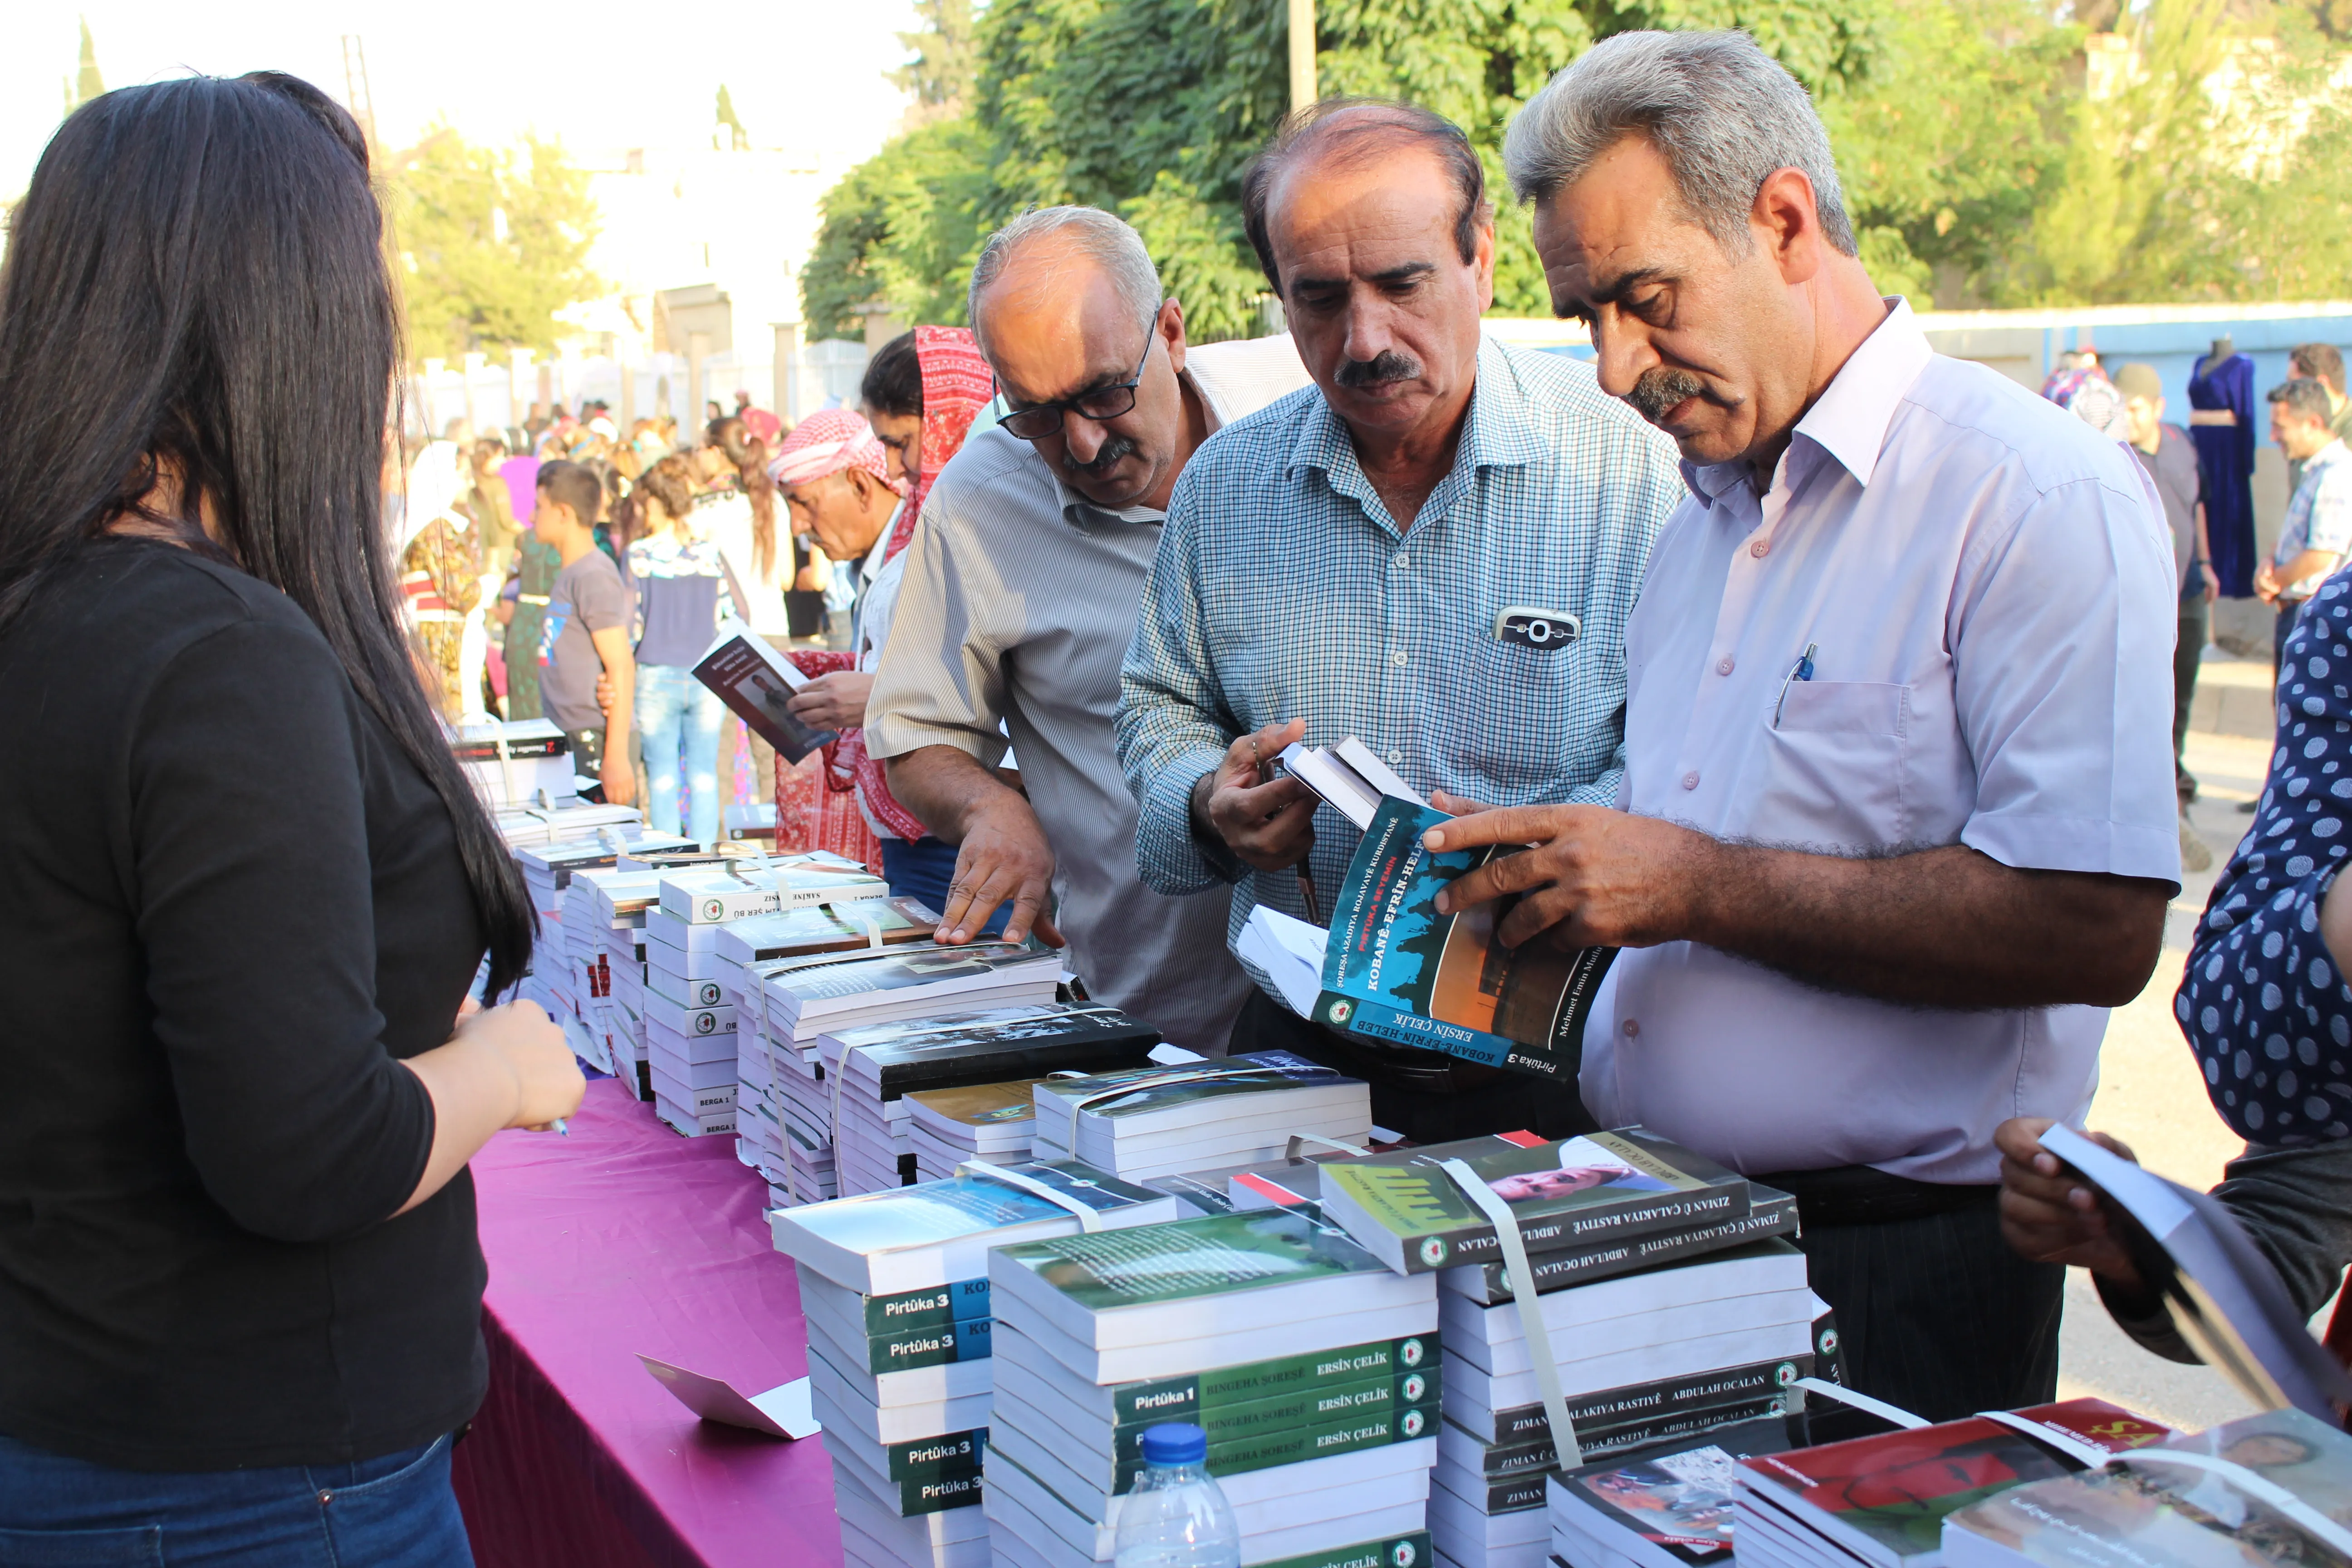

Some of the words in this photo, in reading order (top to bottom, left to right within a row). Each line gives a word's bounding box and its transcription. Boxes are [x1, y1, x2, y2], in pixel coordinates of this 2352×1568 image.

[1337, 954, 1348, 988] ŞOREŞA
[1343, 914, 1358, 952] AZADIYA
[1353, 868, 1374, 912] ROJAVAYÊ
[1370, 817, 1398, 867] KURDISTANÊ
[734, 911, 745, 919] BÛ
[1357, 904, 1378, 951] PIRTÛKA
[1559, 998, 1578, 1037] Mehmet
[1583, 946, 1603, 971] Mutlu
[1392, 1013, 1433, 1031] ÇELÎK
[1433, 1024, 1474, 1042] ERSÎN
[1507, 1054, 1518, 1063] 3
[1519, 1056, 1557, 1073] Pirtûka
[700, 1098, 723, 1106] BERGA
[706, 1124, 730, 1133] BERGA
[1623, 1201, 1681, 1223] ÇALAKIYA
[1684, 1202, 1692, 1215] Û
[1694, 1196, 1730, 1212] ZIMAN
[1573, 1215, 1621, 1234] RASTIYÊ
[1748, 1213, 1780, 1230] ZIMAN
[1521, 1225, 1562, 1240] ABDUL
[1685, 1222, 1736, 1243] ÇALAKIYA
[1458, 1236, 1500, 1252] CALAN
[1639, 1235, 1682, 1255] RASTIYÊ
[1581, 1247, 1629, 1267] ABDULAH
[1536, 1259, 1579, 1277] OCALAN
[886, 1298, 935, 1317] Pirtûka
[937, 1294, 950, 1307] 3
[890, 1338, 939, 1357] Pirtûka
[942, 1334, 954, 1348] 3
[1136, 1390, 1185, 1410] Pirtûka
[1186, 1387, 1194, 1400] 1
[1206, 1376, 1259, 1396] BINGEHA
[1317, 1358, 1351, 1376] ERSÎN
[1353, 1351, 1387, 1370] ÇELÎK
[1207, 1411, 1259, 1431] BINGEHA
[1318, 1394, 1352, 1411] ERSÎN
[1354, 1387, 1389, 1406] ÇELÎK
[1513, 1416, 1548, 1431] ZIMAN
[1568, 1404, 1614, 1420] ALAKIYA
[1617, 1392, 1661, 1411] RASTIYÊ
[1672, 1383, 1720, 1401] ABDULAH
[1723, 1375, 1764, 1391] OCALAN
[1205, 1448, 1258, 1469] BINGEHA
[1317, 1430, 1351, 1447] ERSÎN
[1353, 1423, 1387, 1441] ÇELÎK
[1501, 1453, 1537, 1468] ZIMAN
[1606, 1428, 1651, 1446] RASTIYÊ
[1662, 1417, 1711, 1434] ABDULAH
[1713, 1408, 1755, 1423] OCALAN
[909, 1446, 956, 1464] Pirtûka
[960, 1441, 971, 1453] 3
[922, 1480, 969, 1499] Pirtûka
[972, 1476, 983, 1488] 3
[1507, 1488, 1542, 1504] ZIMAN
